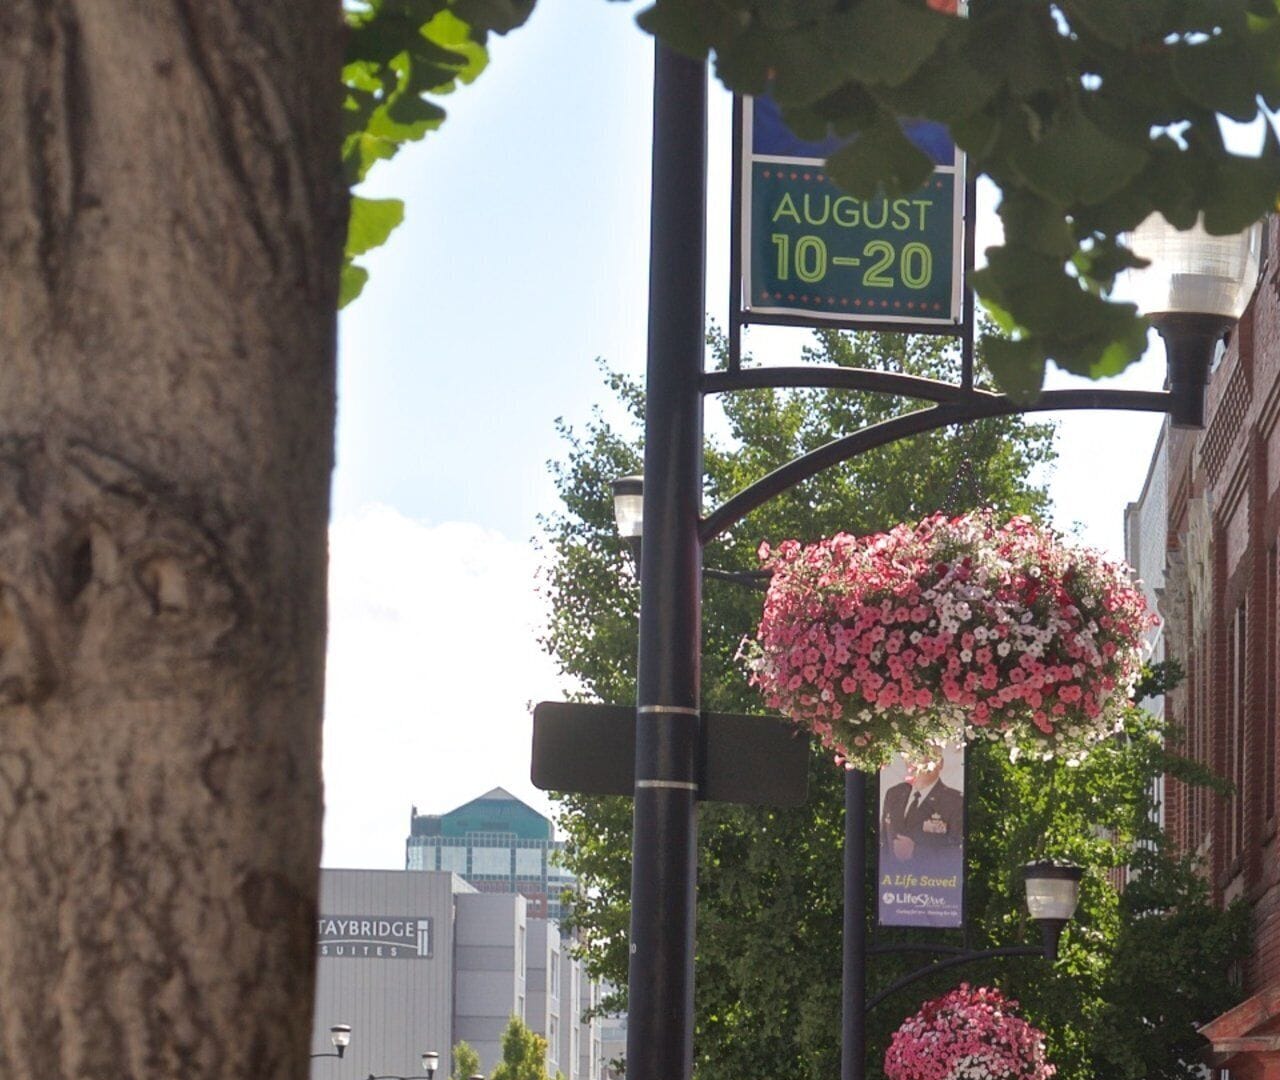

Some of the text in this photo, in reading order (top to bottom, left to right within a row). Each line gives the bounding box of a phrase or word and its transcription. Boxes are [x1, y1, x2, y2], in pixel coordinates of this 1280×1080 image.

[772, 192, 933, 231] AUGUST
[882, 875, 956, 888] A Life Saved
[318, 920, 414, 937] TAYBRIDGE
[322, 945, 397, 956] SUITES
